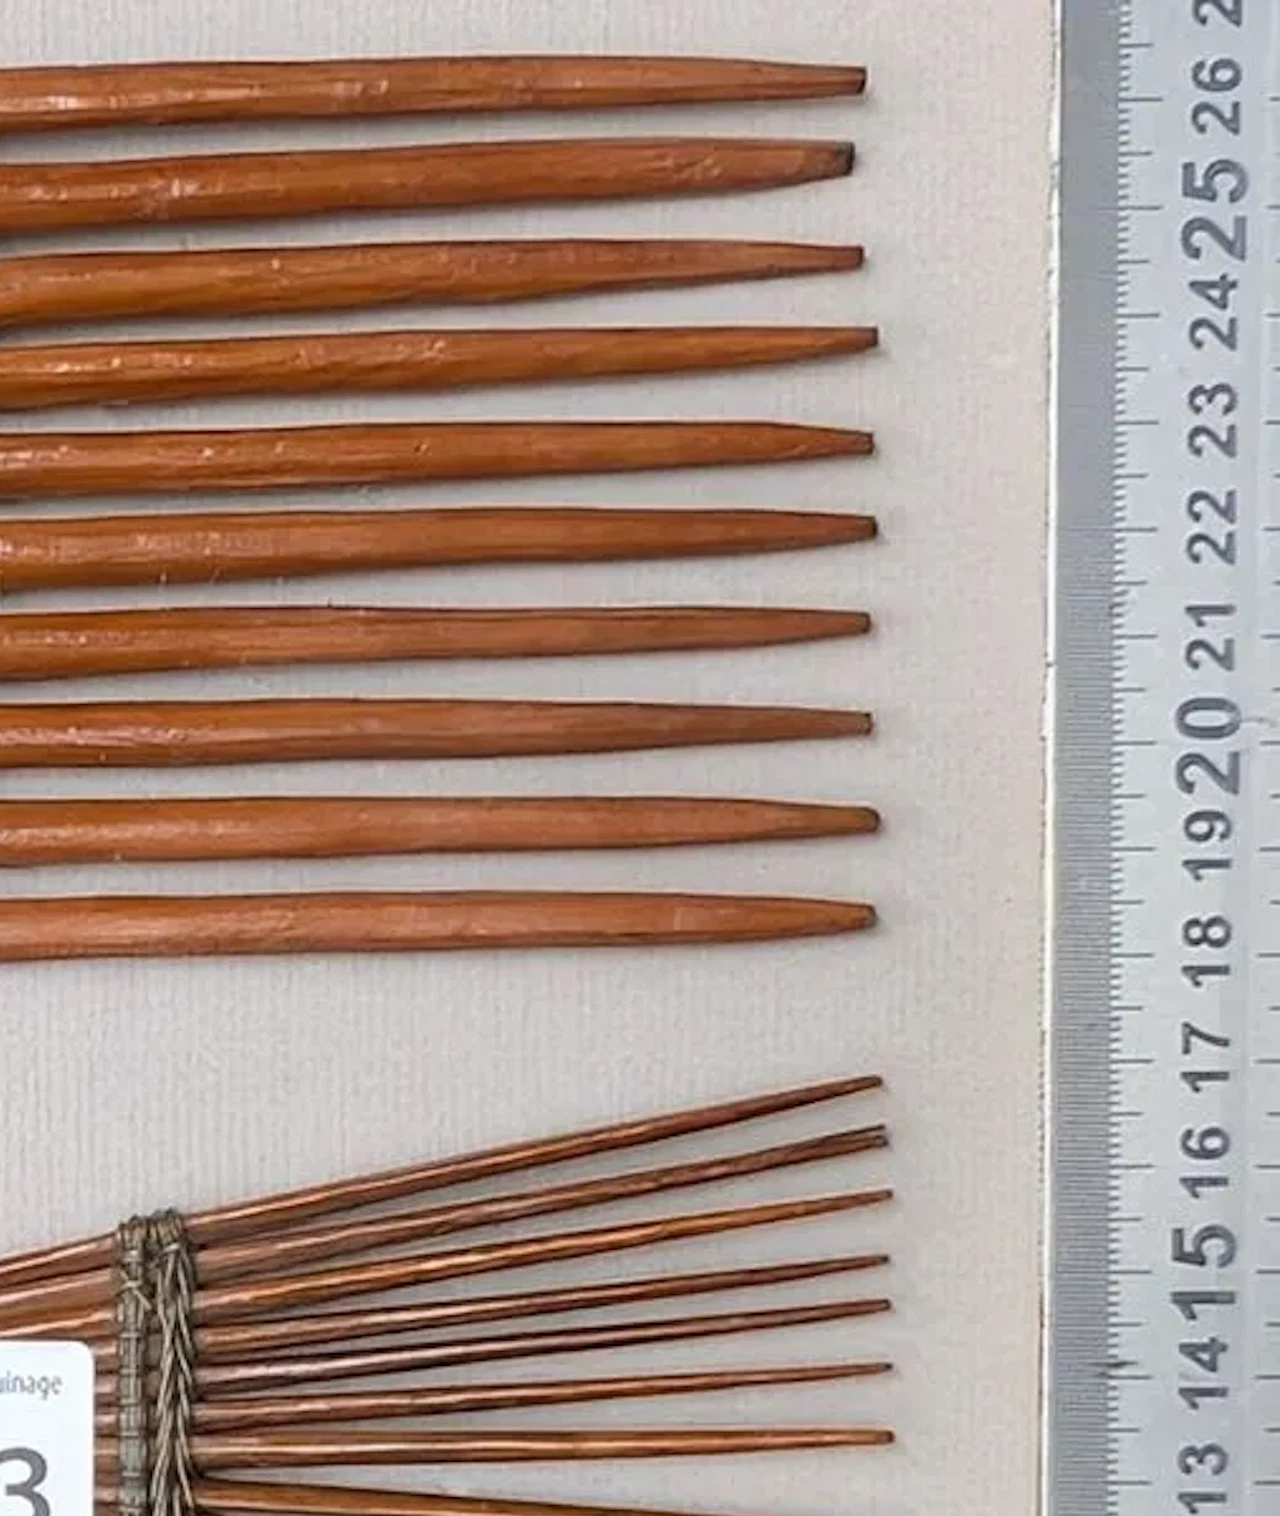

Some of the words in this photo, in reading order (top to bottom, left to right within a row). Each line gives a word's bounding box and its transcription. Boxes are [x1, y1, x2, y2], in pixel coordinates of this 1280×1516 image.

[1191, 57, 1242, 136] 26
[1180, 158, 1249, 262] 25
[1188, 272, 1239, 351] 24
[1186, 382, 1238, 459] 23
[1185, 489, 1238, 566] 22
[1183, 603, 1236, 672] 21
[1174, 696, 1241, 796] 20
[1181, 809, 1233, 881] 19
[1181, 914, 1233, 988] 18
[1179, 1020, 1231, 1094] 17
[1178, 1126, 1231, 1199] 16
[1169, 1223, 1237, 1322] 15
[1178, 1336, 1229, 1411] 14
[1176, 1442, 1229, 1515] 13
